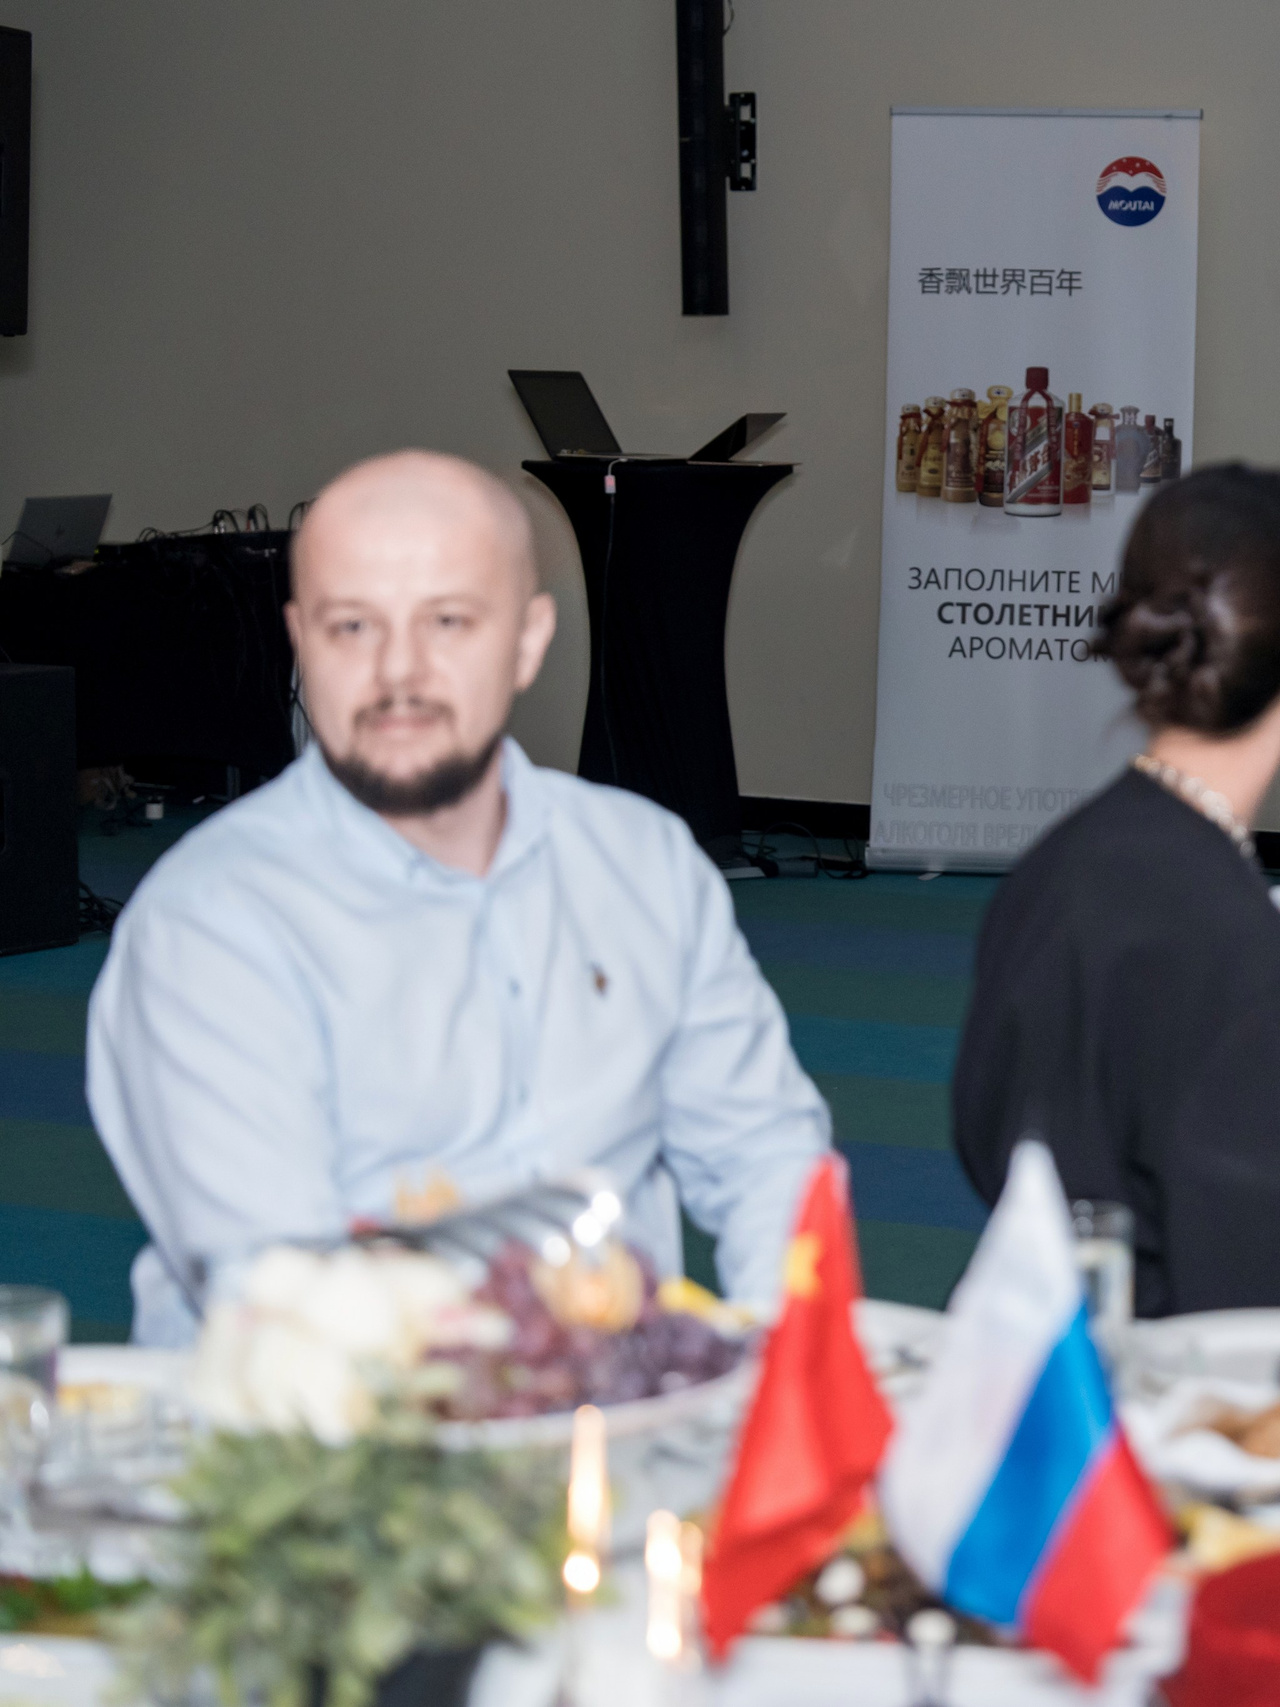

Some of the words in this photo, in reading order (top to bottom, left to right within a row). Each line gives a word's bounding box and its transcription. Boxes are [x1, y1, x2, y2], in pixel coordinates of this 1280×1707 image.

[1107, 199, 1155, 212] MOUTAI
[918, 267, 1083, 297] 香飘世界百年
[907, 566, 1081, 594] ЗАПОЛНИТЕ
[1091, 571, 1121, 595] М
[936, 601, 1104, 629] СТОЛЕТНИ
[948, 636, 1110, 663] АРОМАТО
[883, 783, 1012, 811] ЧРЕЗМЕРНОЕ
[873, 820, 979, 846] АЛКОГОЛЯ
